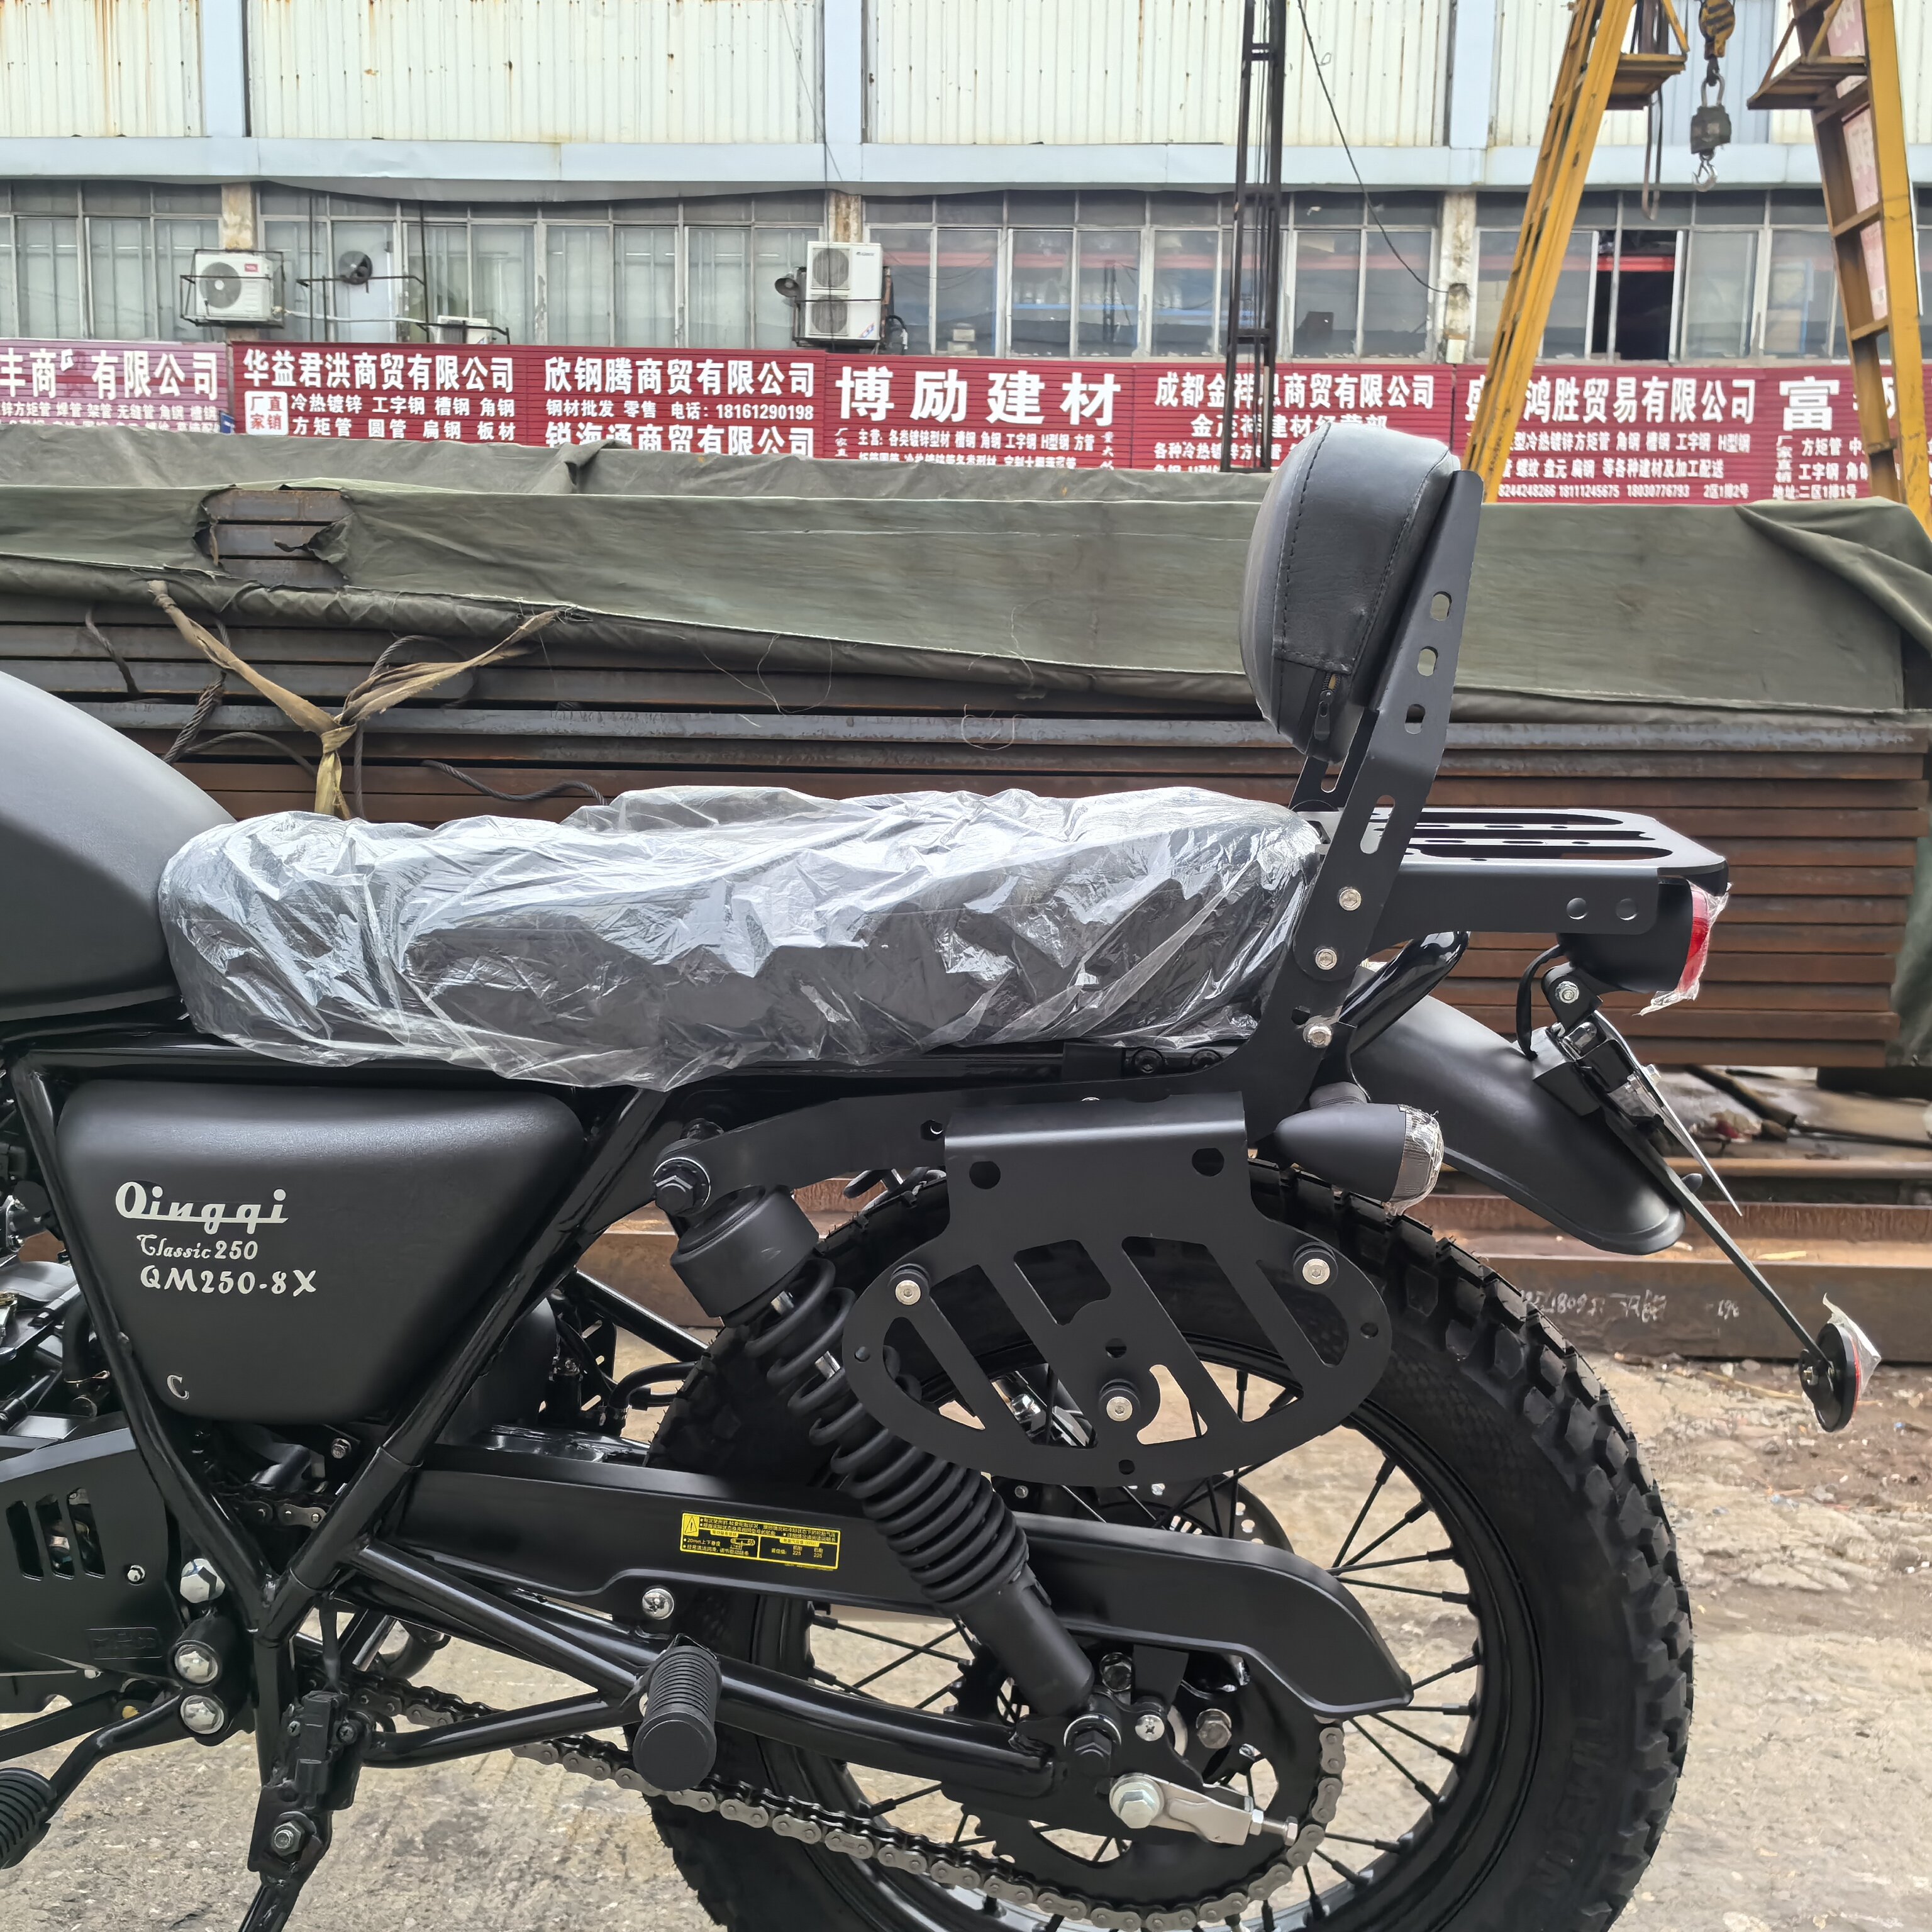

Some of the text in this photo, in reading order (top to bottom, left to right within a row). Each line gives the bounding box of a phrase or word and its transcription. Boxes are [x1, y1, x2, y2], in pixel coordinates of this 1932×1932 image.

[0, 347, 218, 401] 丰商有限公司
[243, 348, 514, 393] 华益君洪商贸有限公司
[544, 356, 814, 398] 欣钢腾商贸有限公司
[291, 393, 515, 418] 冷热镀锌 工字钢 槽钢 角钢
[546, 399, 614, 418] 钢材批发
[623, 400, 657, 419] 零售
[835, 365, 1122, 427] 博励建材
[1465, 374, 1756, 425] 鸿胜贸易有限公司
[292, 416, 516, 441] 方矩管 圆管 扁钢 板材
[1005, 432, 1036, 450] 工字钢
[115, 1181, 289, 1235] Qingqi
